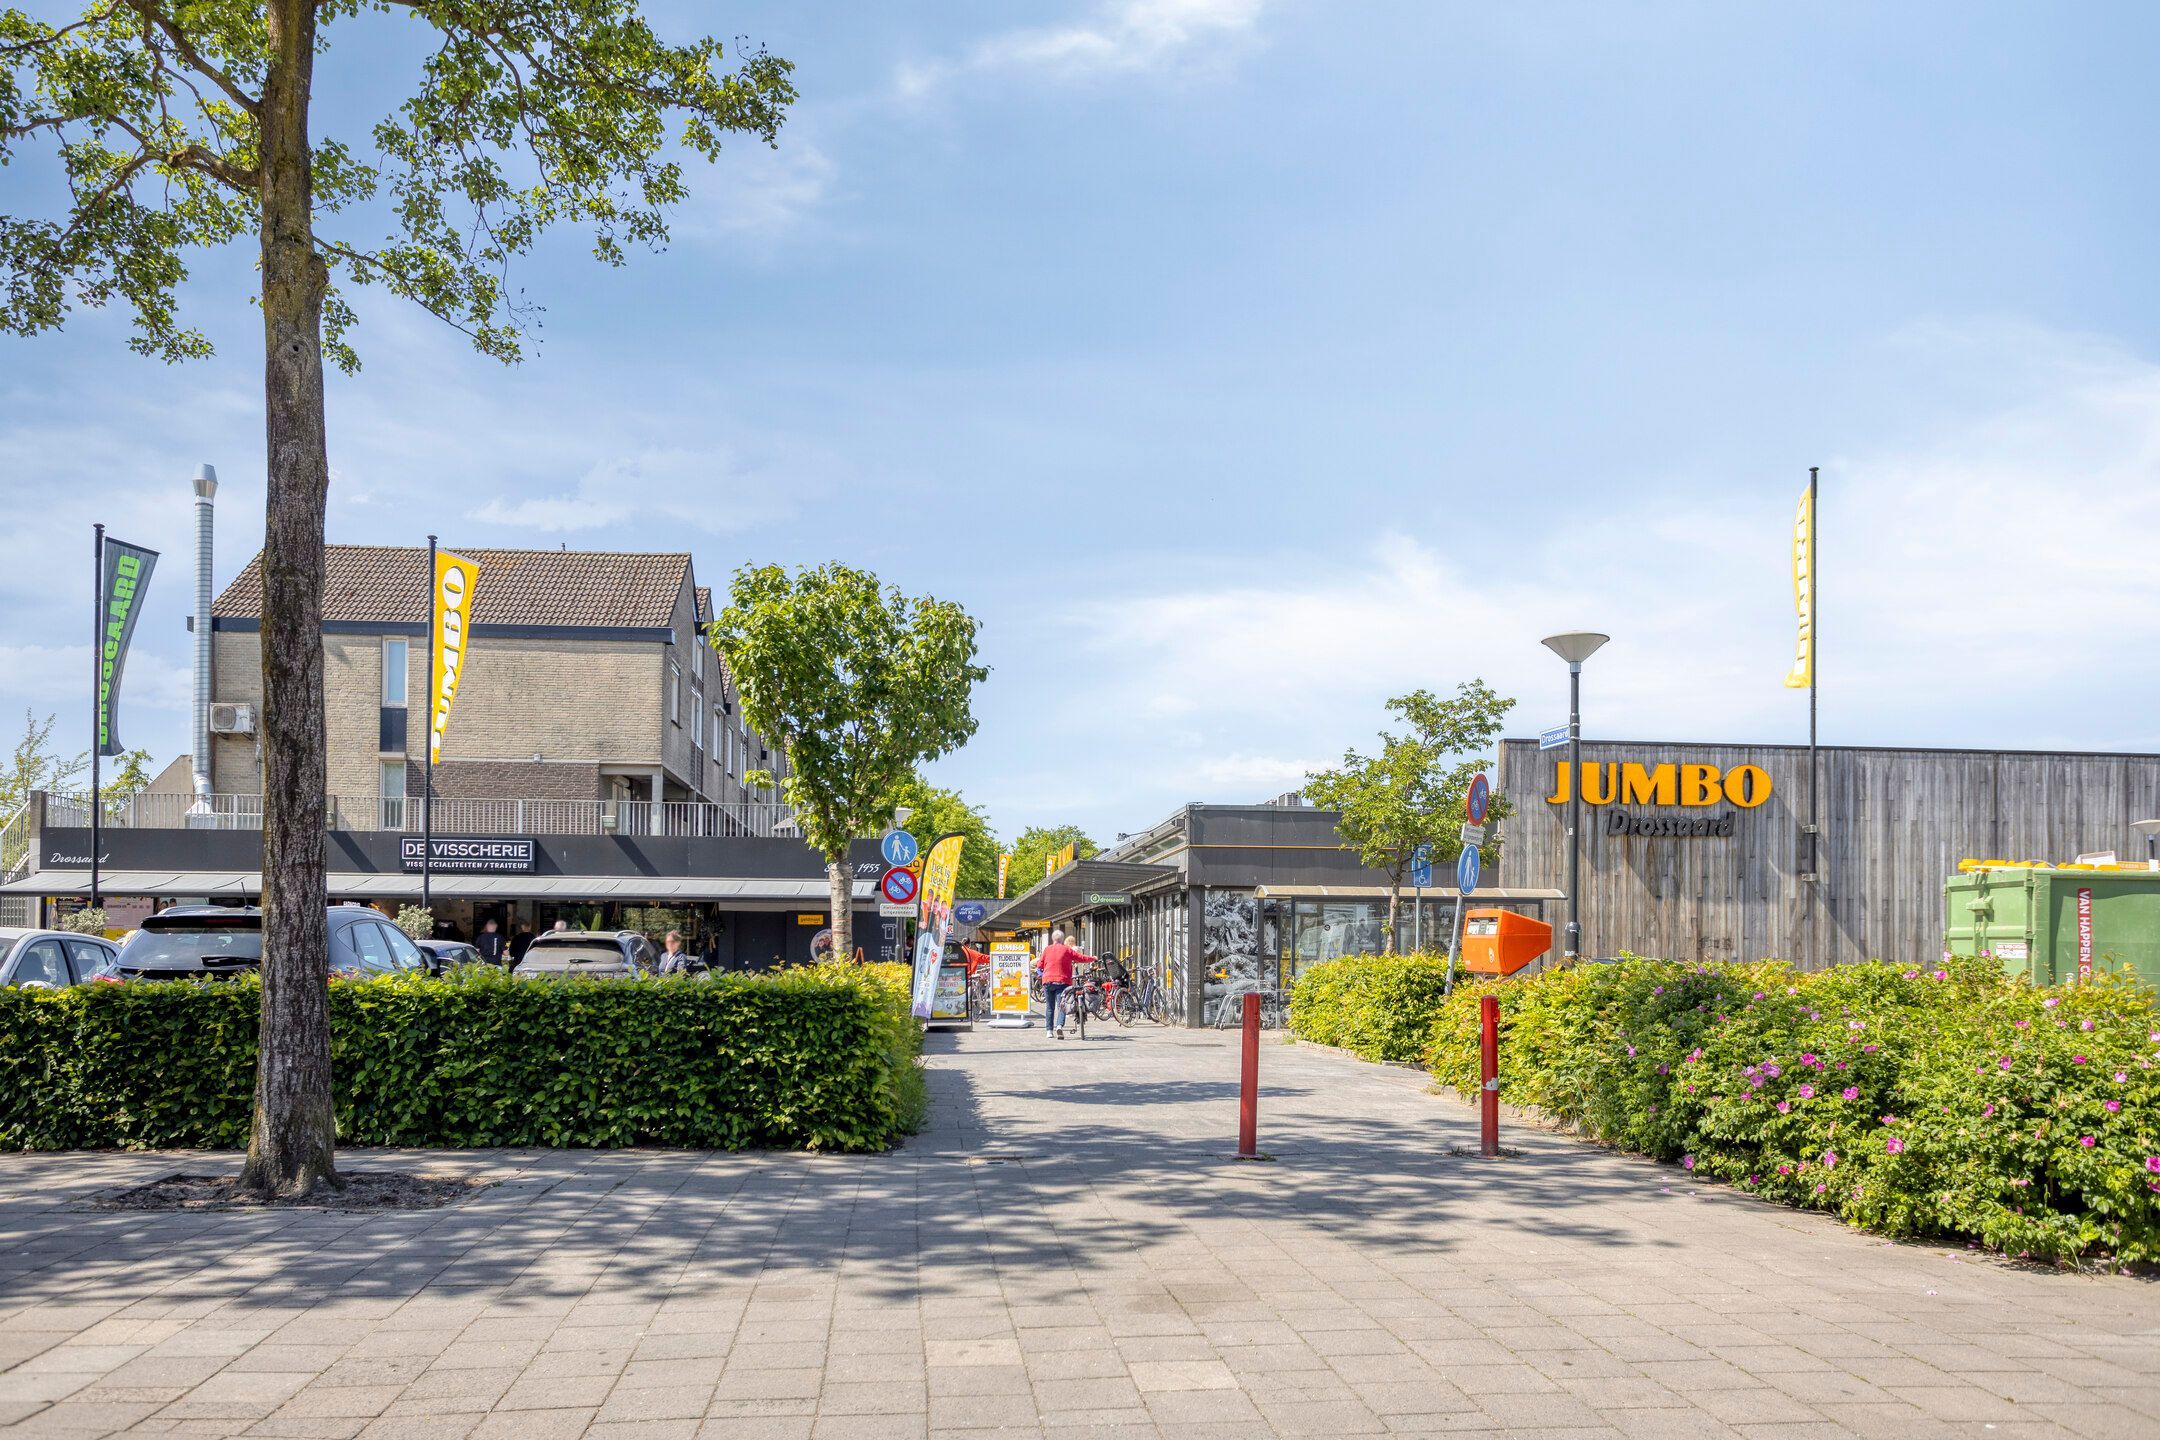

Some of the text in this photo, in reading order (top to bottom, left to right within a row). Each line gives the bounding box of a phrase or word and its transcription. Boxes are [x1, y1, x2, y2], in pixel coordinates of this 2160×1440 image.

[1541, 730, 1569, 744] Drossaard
[1546, 761, 1773, 808] JUMBO
[1607, 810, 1736, 837] Drossaard
[50, 852, 109, 864] Drossaad
[405, 843, 528, 857] DE VISSCHERIE
[857, 863, 881, 873] 1955
[2079, 890, 2090, 914] VAN
[2079, 917, 2091, 962] HAPPEN
